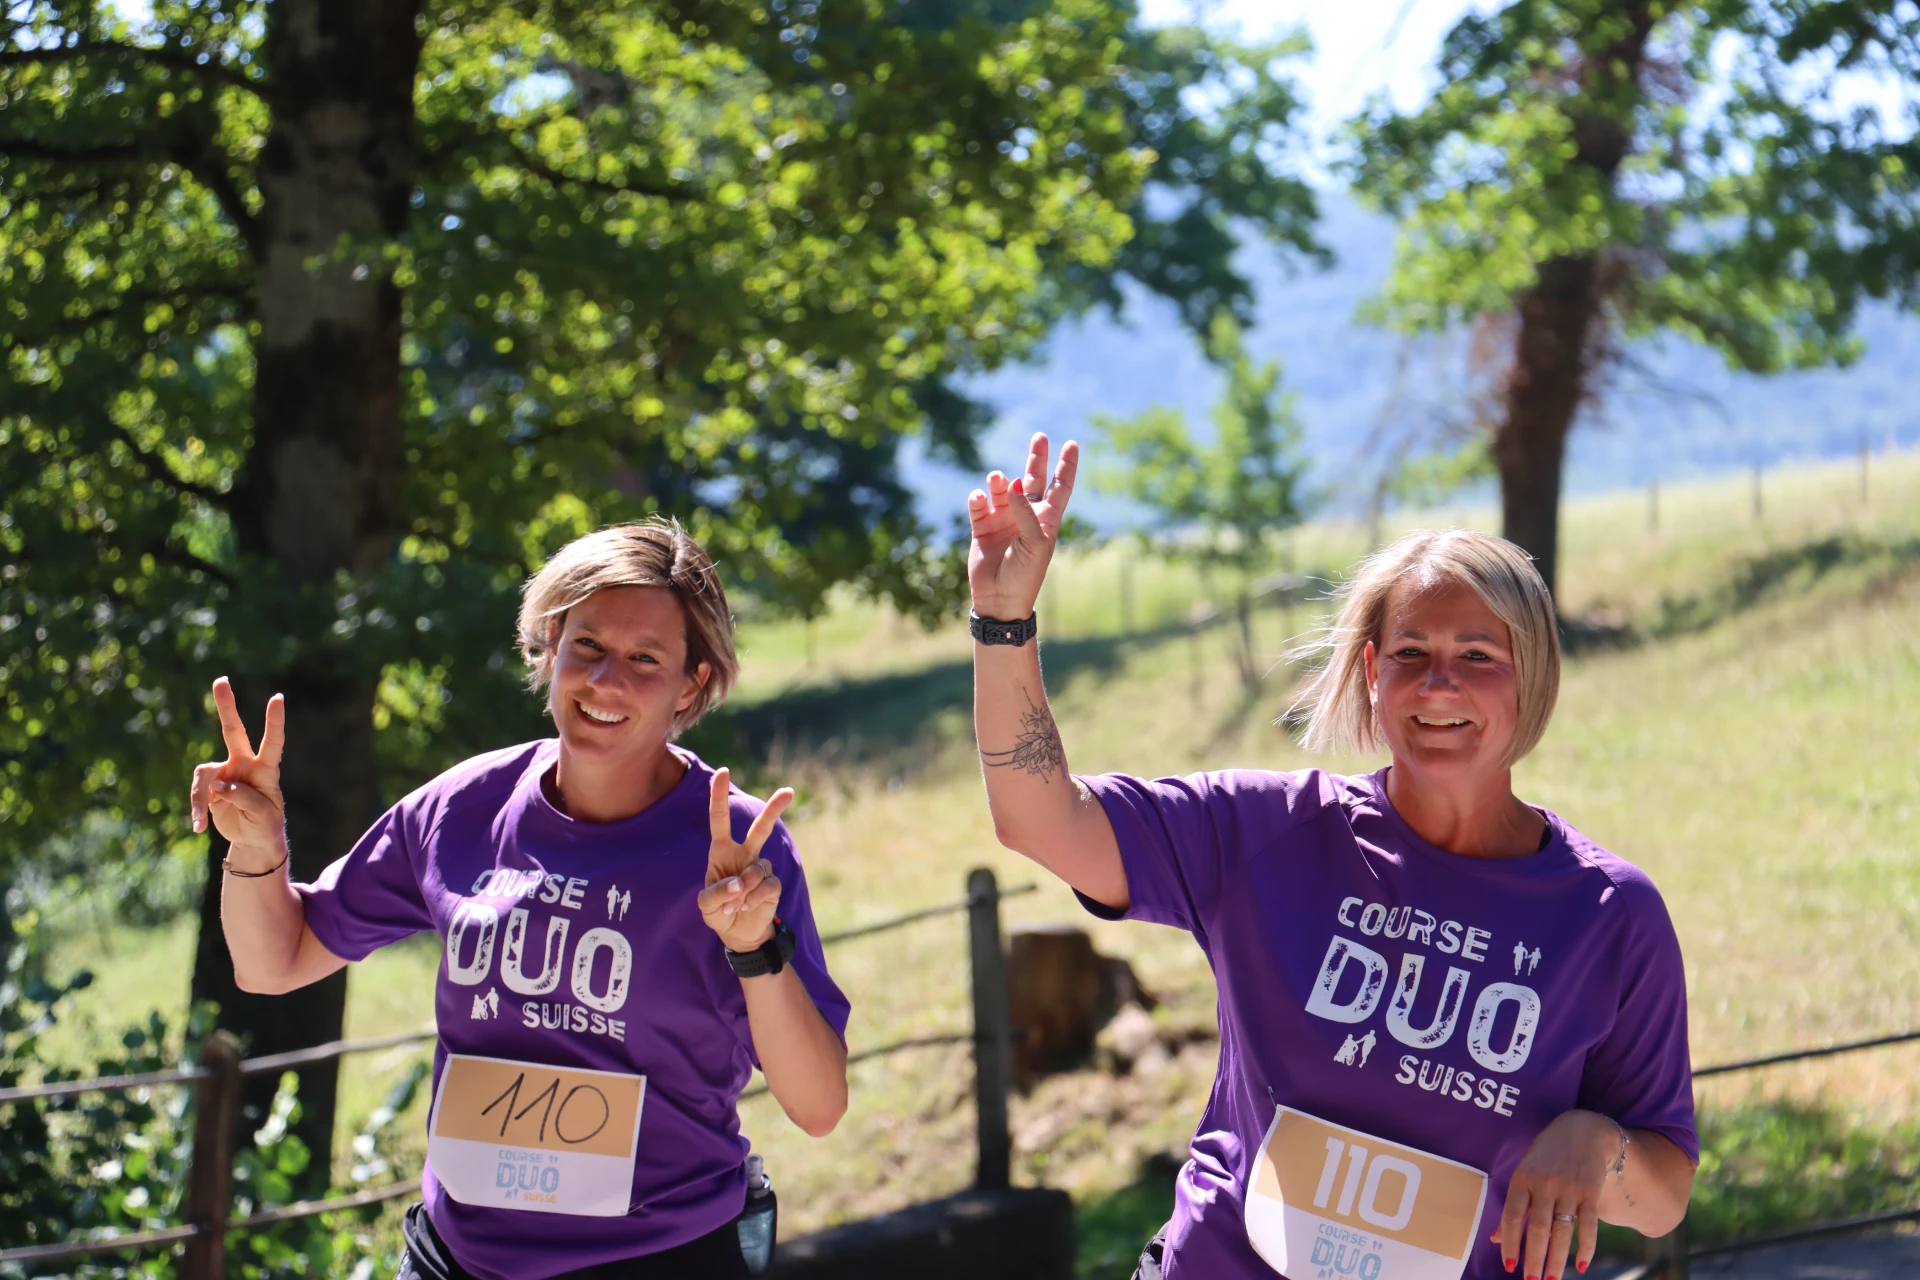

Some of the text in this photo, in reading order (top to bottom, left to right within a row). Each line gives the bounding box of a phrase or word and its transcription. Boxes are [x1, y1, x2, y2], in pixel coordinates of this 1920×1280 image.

[471, 870, 588, 909] COURSE
[1337, 896, 1492, 962] COURSE
[447, 904, 632, 1014] DUO
[522, 1002, 625, 1041] SUISSE
[1304, 934, 1541, 1073] DUO
[1395, 1054, 1520, 1117] SUISSE
[481, 1072, 609, 1144] 110
[496, 1162, 559, 1193] DUO
[498, 1149, 543, 1163] COURSE
[523, 1192, 557, 1203] SUISSE
[1313, 1136, 1422, 1231] 110
[1318, 1223, 1368, 1247] COURSE
[1310, 1236, 1382, 1280] DUO
